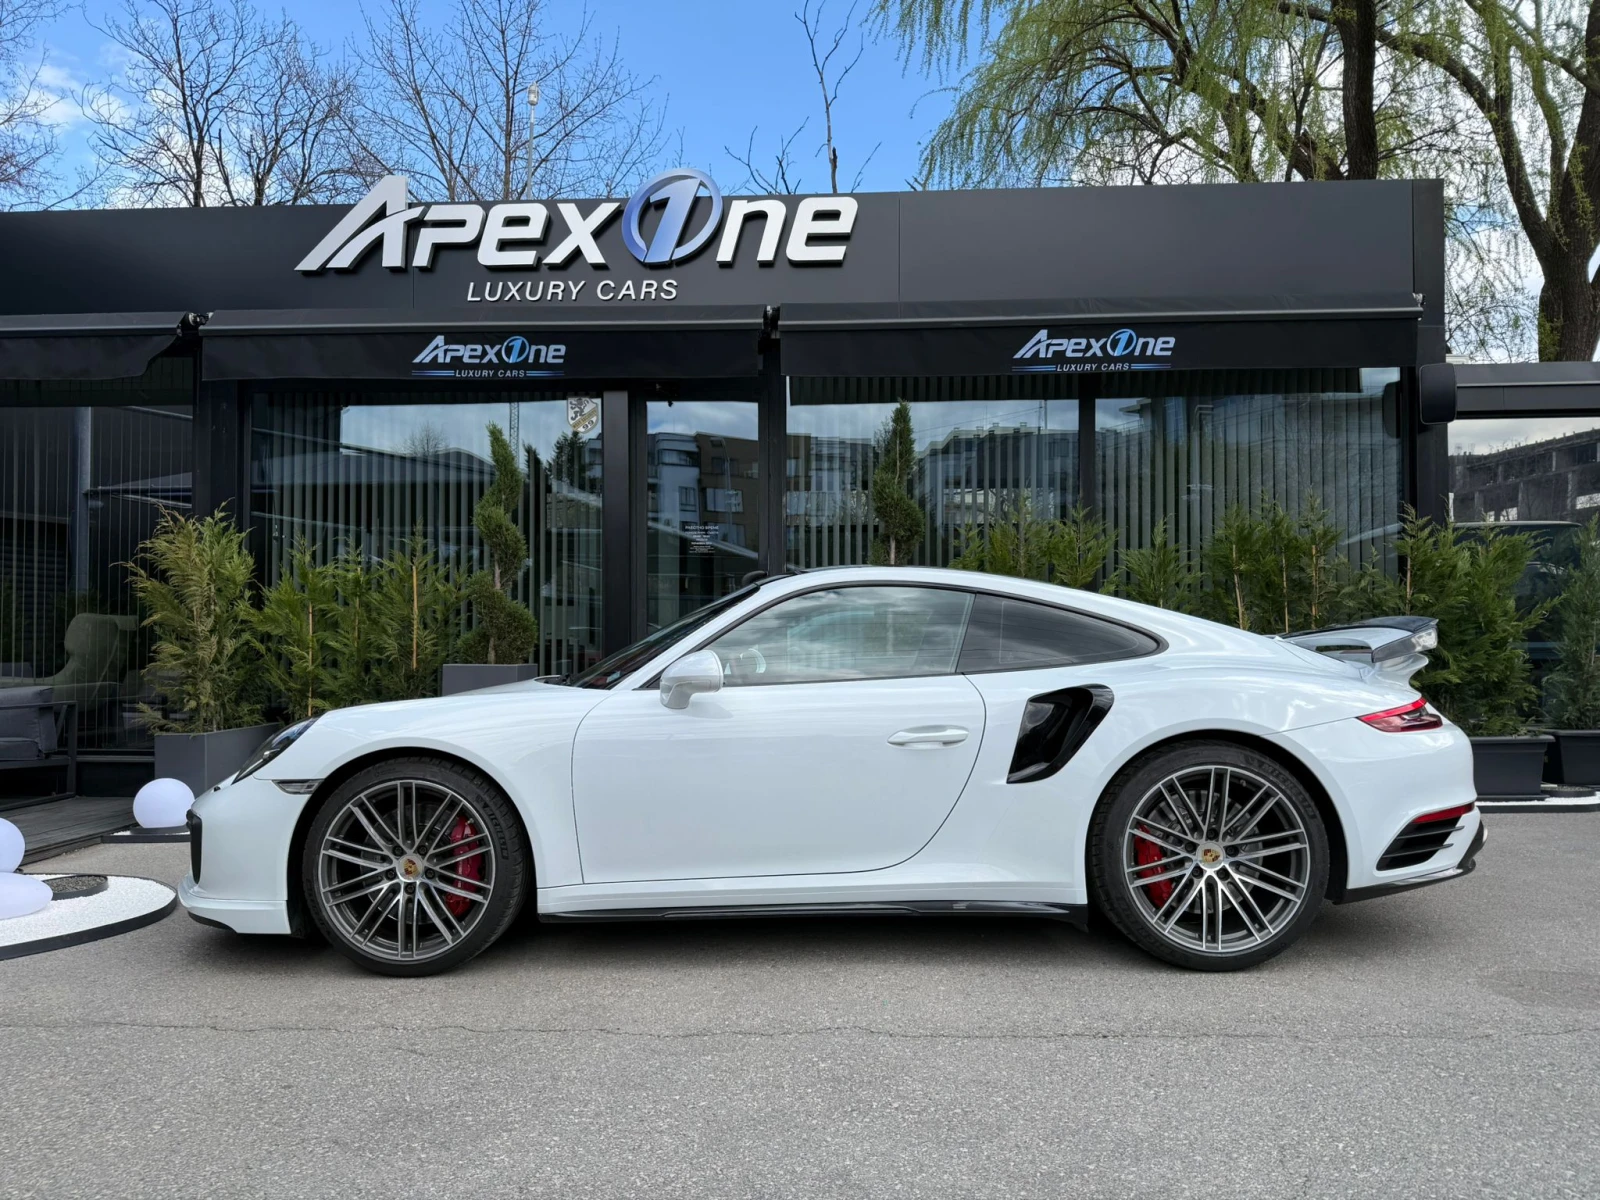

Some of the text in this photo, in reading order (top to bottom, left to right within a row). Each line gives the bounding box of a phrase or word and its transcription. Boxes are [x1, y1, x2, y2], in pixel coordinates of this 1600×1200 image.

[466, 279, 679, 302] LUXURY CARS
[1056, 362, 1130, 372] LUXURY CARS
[455, 369, 525, 378] LUXURY CARS
